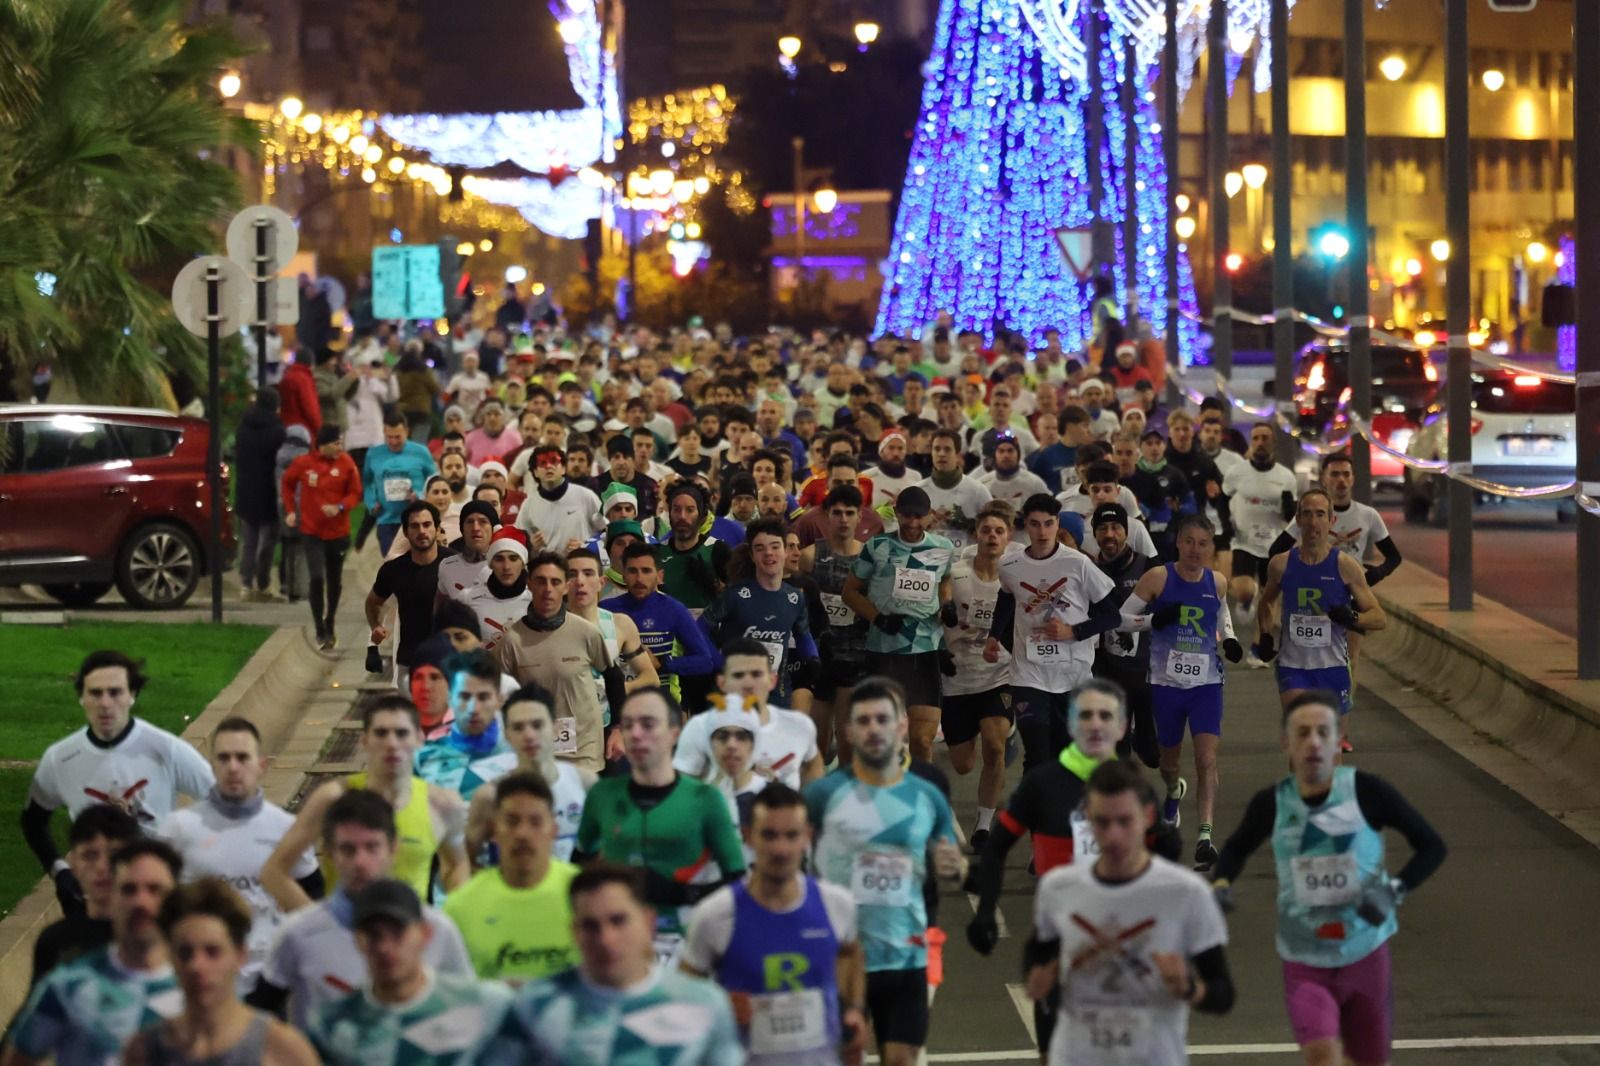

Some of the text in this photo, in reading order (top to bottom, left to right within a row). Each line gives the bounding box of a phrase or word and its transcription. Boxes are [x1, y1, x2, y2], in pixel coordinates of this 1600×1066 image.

[899, 579, 930, 592] 1200
[826, 605, 848, 617] 573
[975, 609, 995, 620] 26
[1180, 605, 1208, 637] R
[1296, 626, 1323, 638] 684
[1036, 644, 1060, 657] 591
[1174, 663, 1201, 676] 938
[862, 873, 902, 891] 603
[1305, 875, 1348, 890] 940
[763, 952, 810, 992] R
